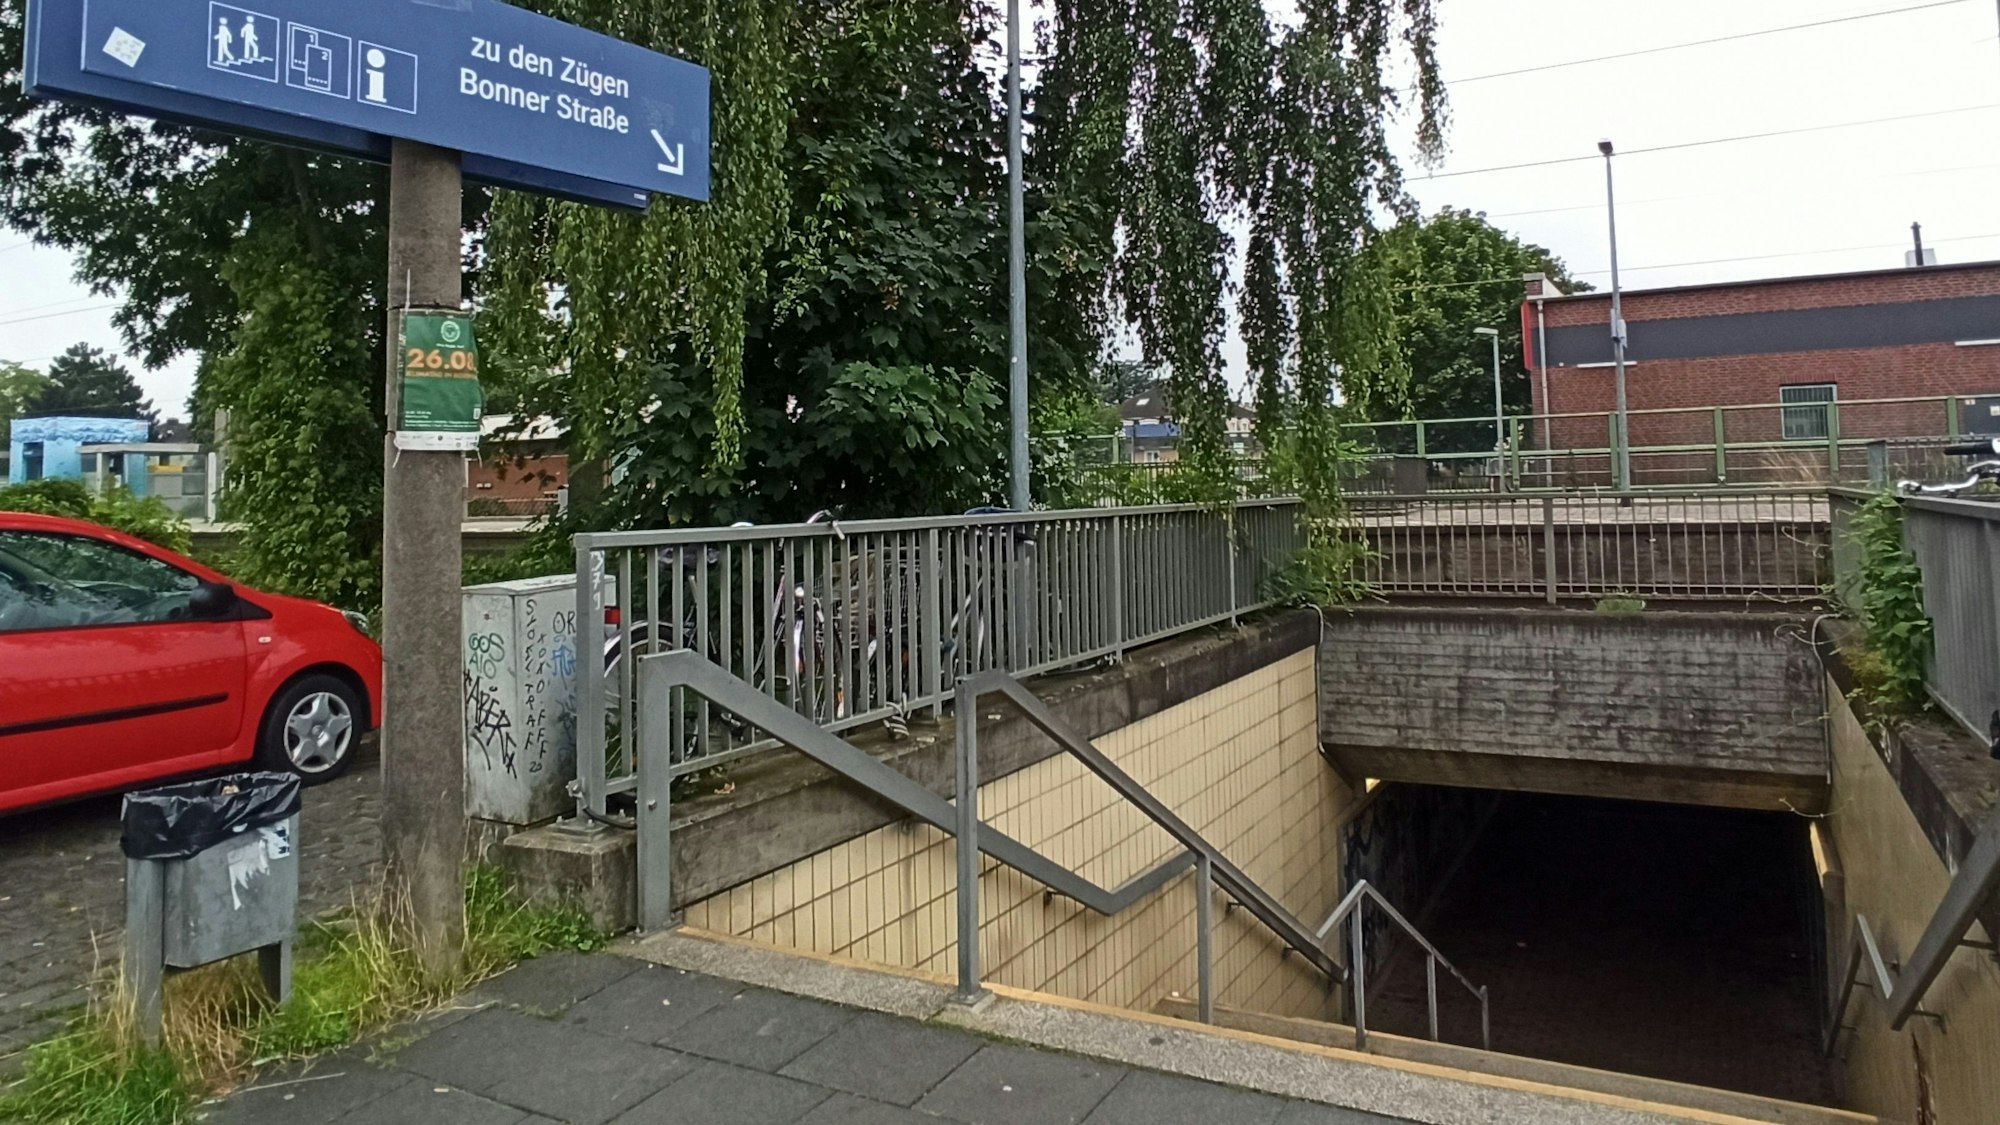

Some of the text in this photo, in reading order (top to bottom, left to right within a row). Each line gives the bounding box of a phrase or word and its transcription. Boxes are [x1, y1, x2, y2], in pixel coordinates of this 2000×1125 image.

[321, 51, 328, 60] 2
[471, 37, 629, 98] zu den Zügen
[460, 67, 629, 133] Bonner Straße
